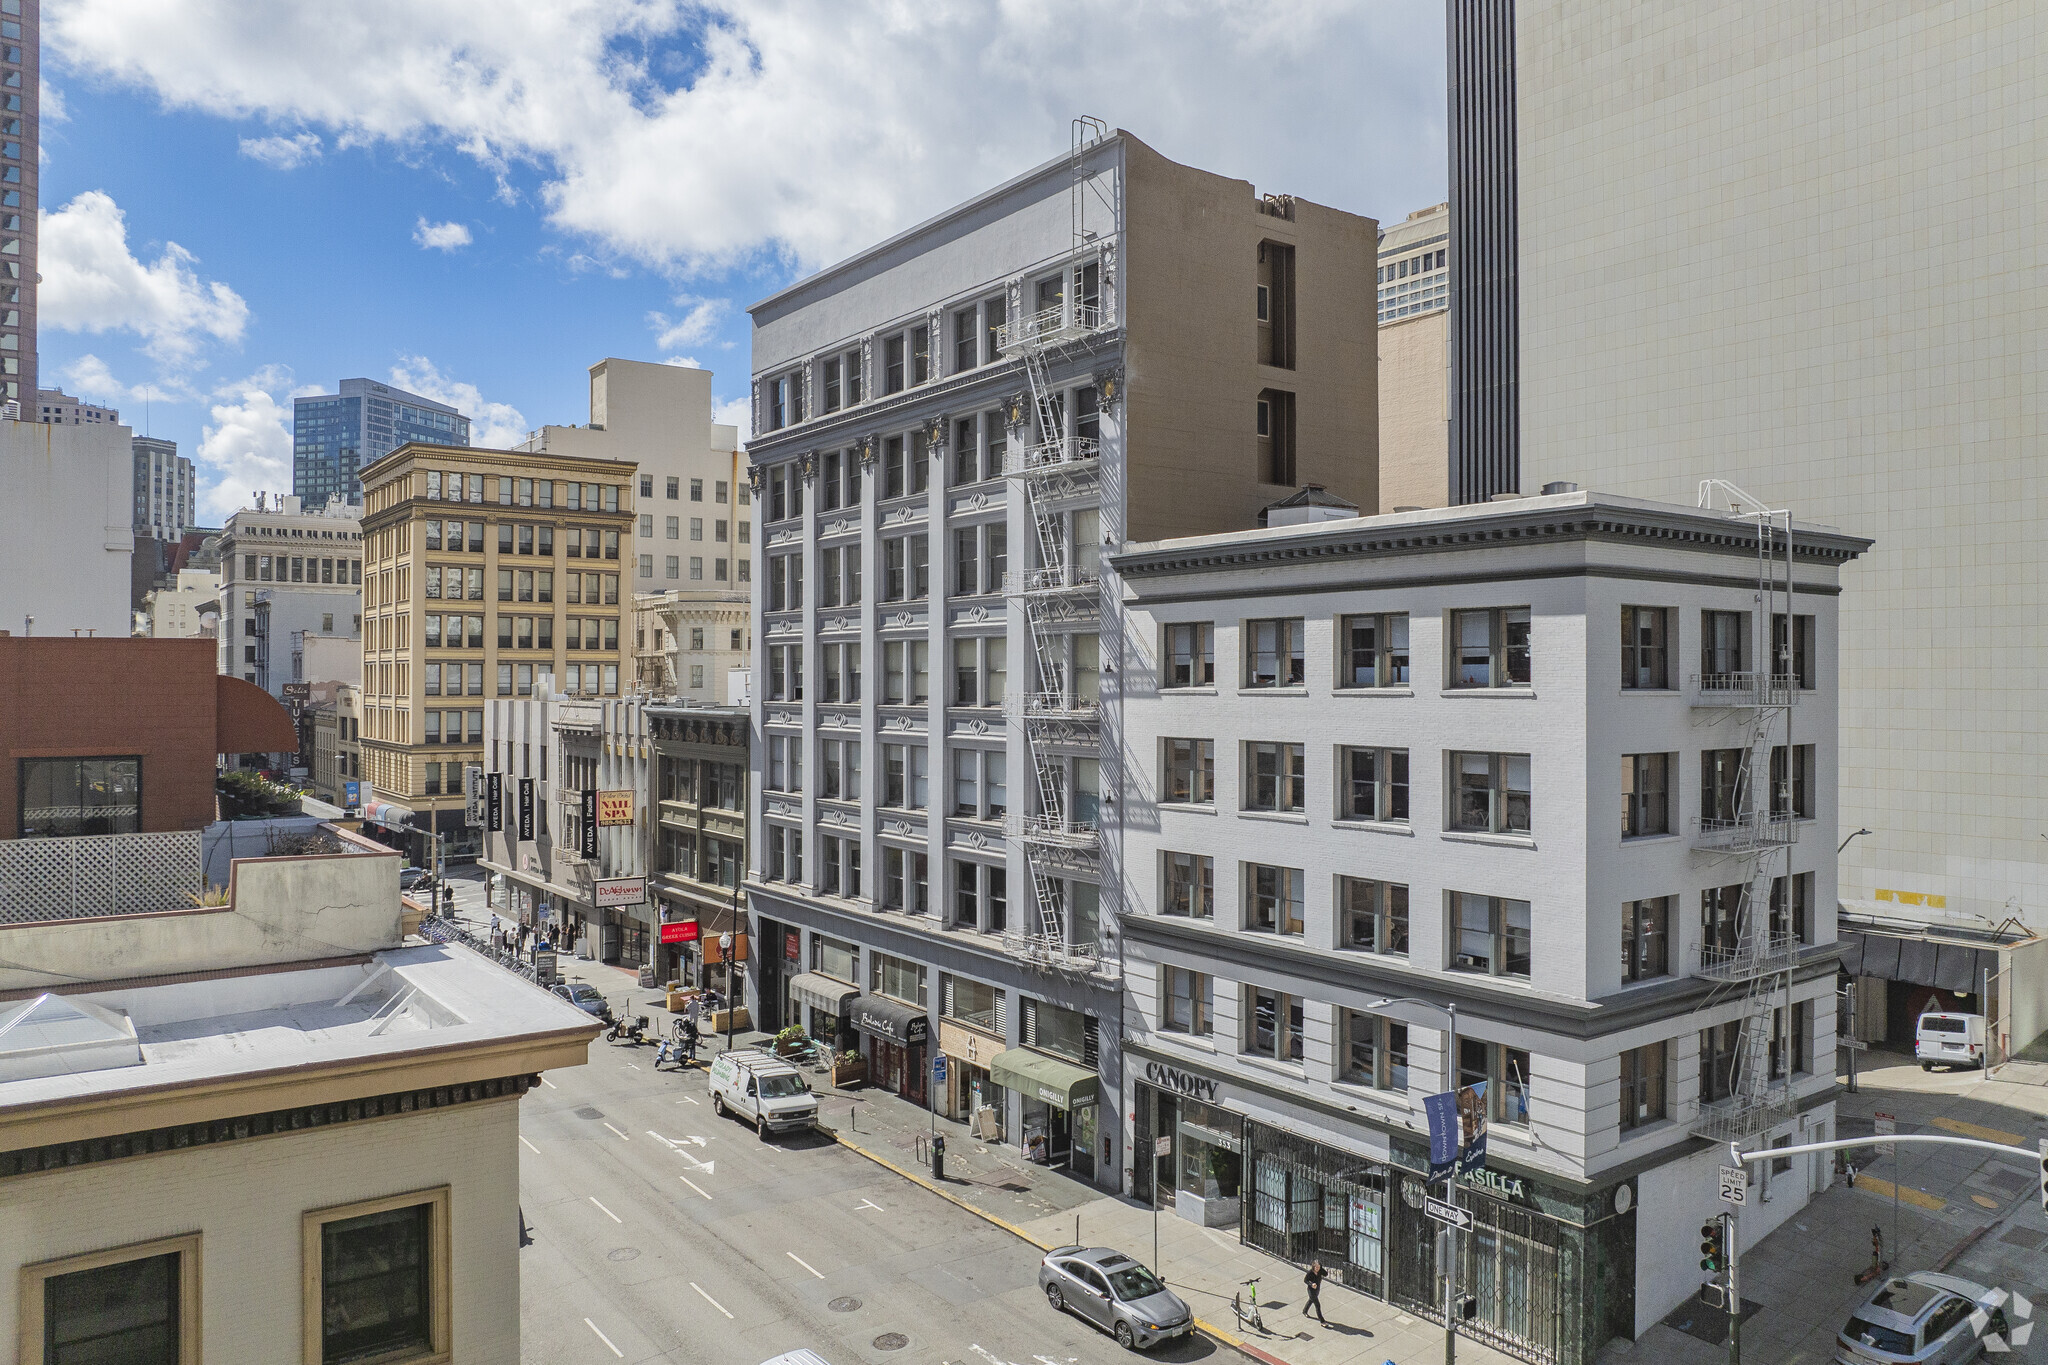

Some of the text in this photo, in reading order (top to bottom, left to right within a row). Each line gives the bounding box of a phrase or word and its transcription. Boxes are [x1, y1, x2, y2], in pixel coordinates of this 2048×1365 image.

[292, 699, 300, 765] TUXES
[601, 800, 631, 809] NAIL
[604, 809, 627, 818] SPA
[1146, 1062, 1219, 1100] CANOPY
[1039, 1087, 1064, 1104] ONIGILLY
[1072, 1094, 1095, 1105] ONIGILLY
[1217, 1138, 1231, 1149] 353
[1720, 1168, 1745, 1180] SPEED
[1723, 1177, 1741, 1187] LIMIT
[1721, 1184, 1744, 1202] 25
[1429, 1202, 1459, 1220] ONE WAY
